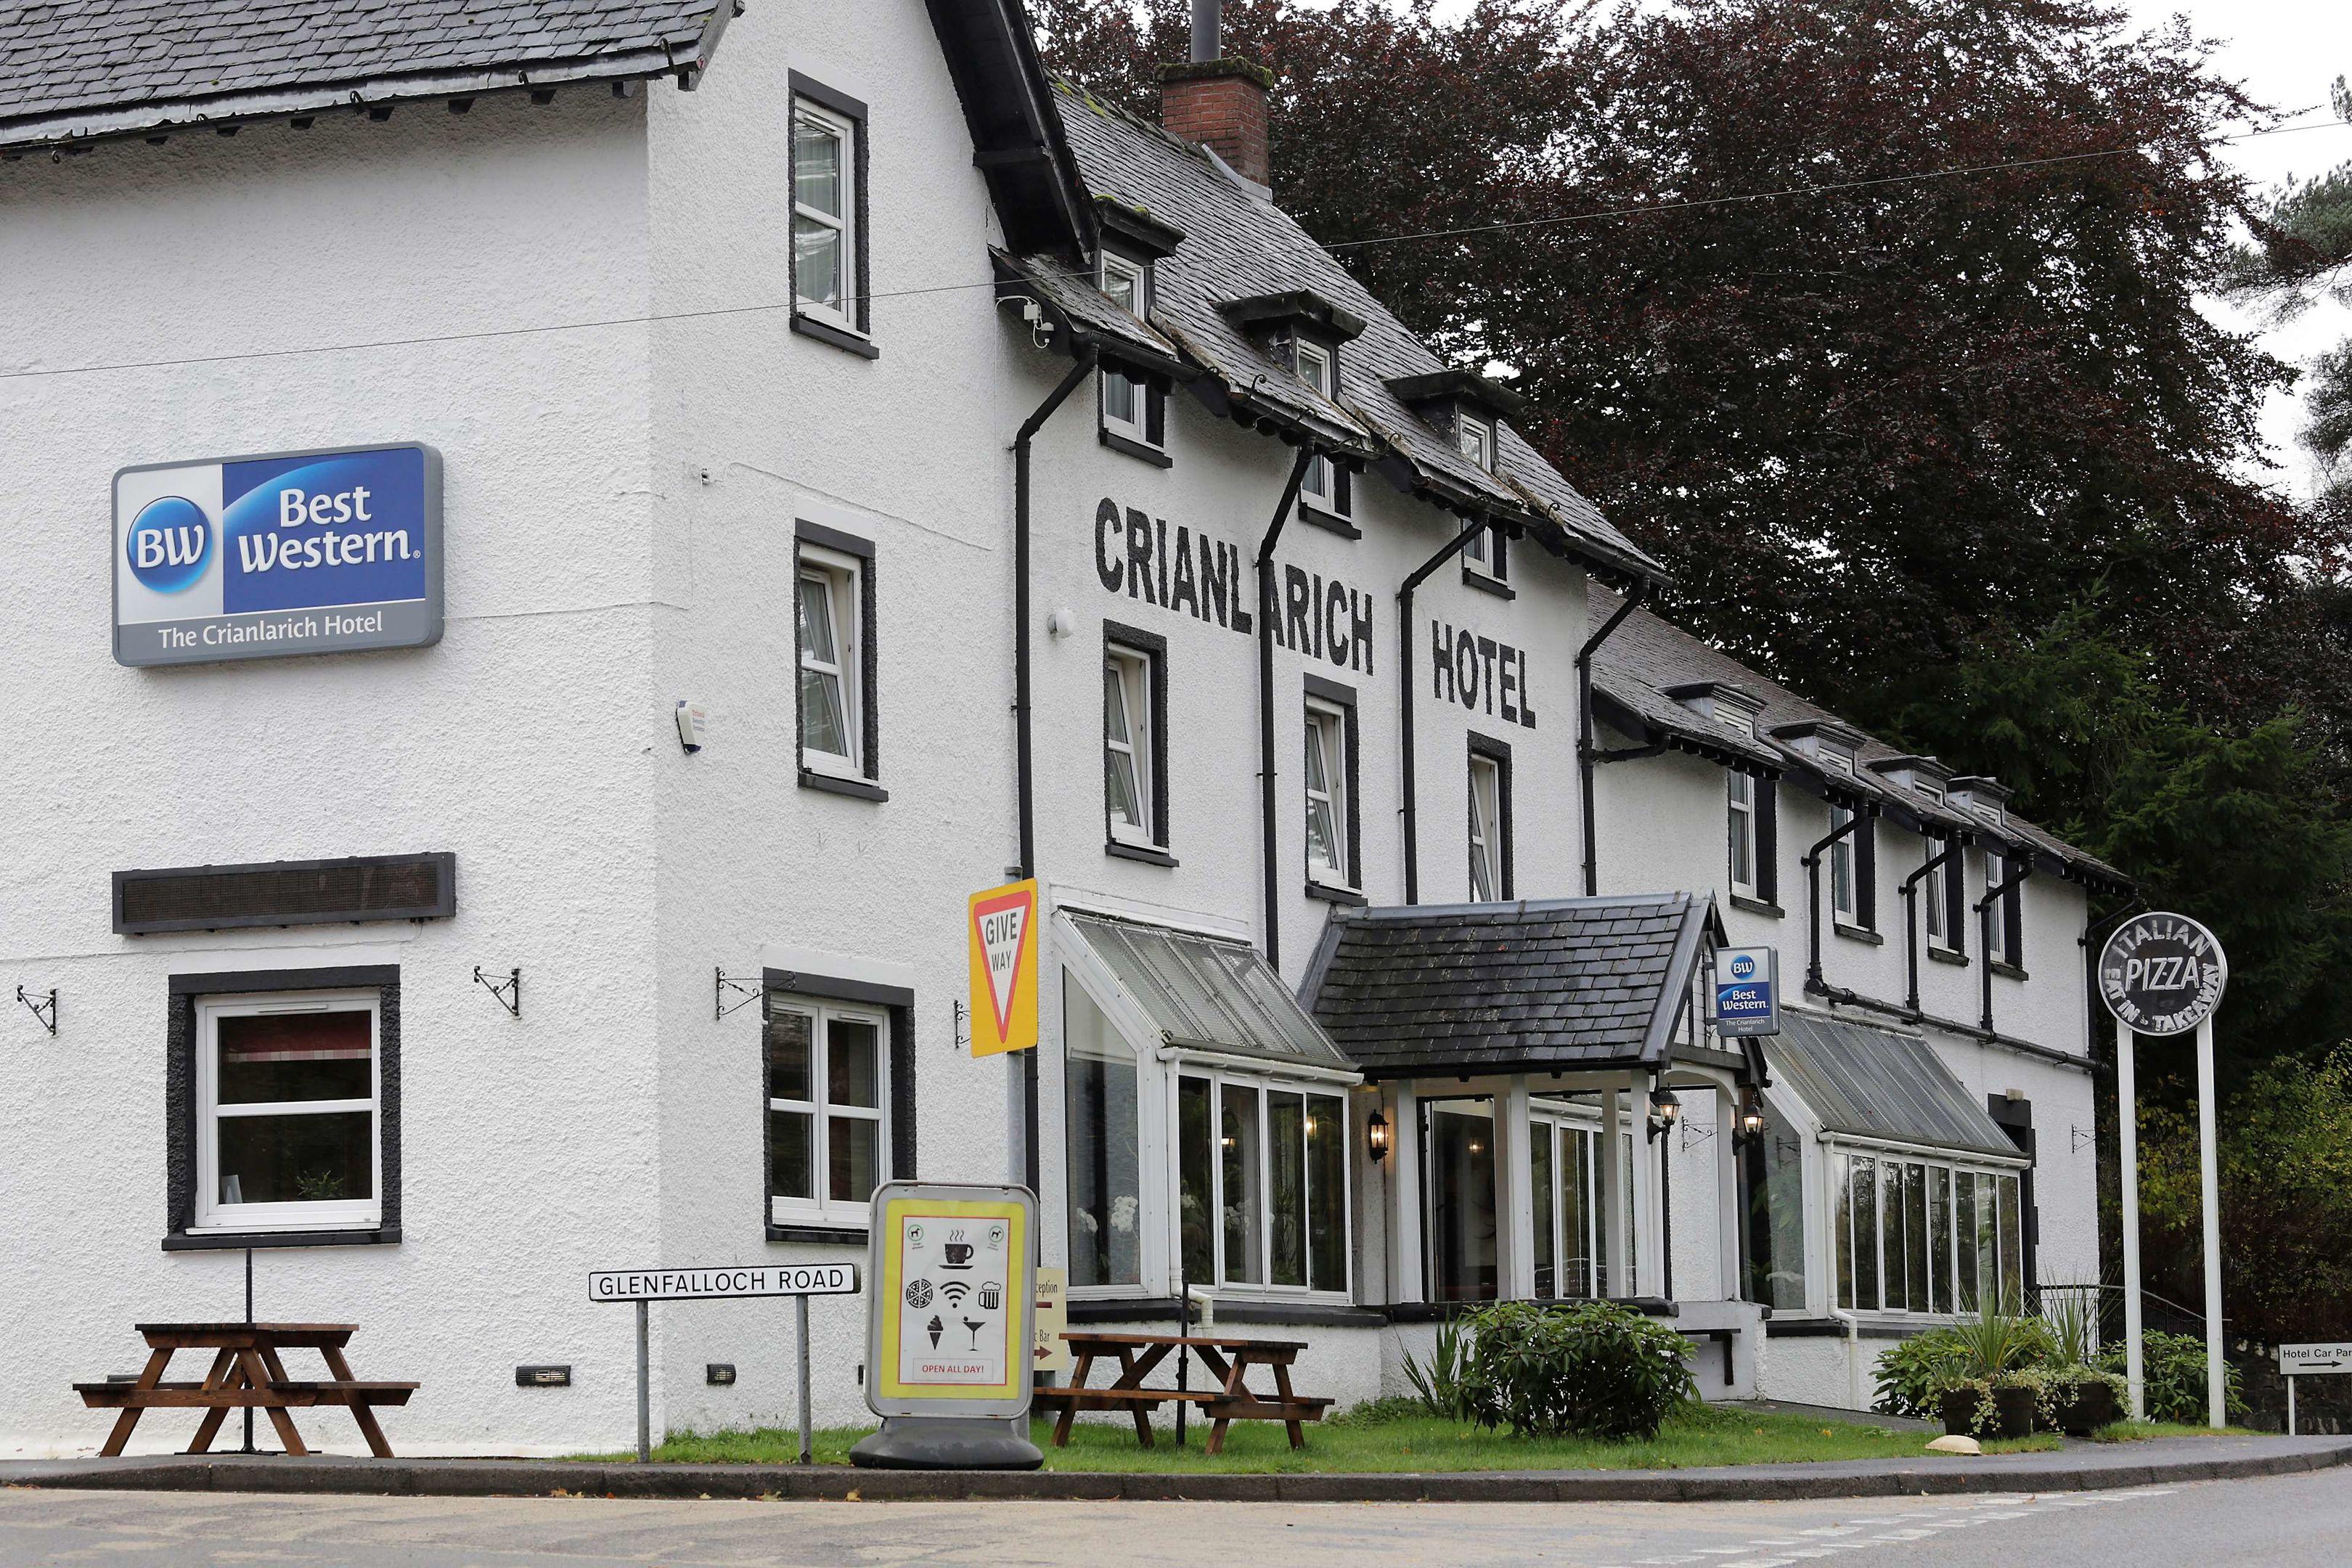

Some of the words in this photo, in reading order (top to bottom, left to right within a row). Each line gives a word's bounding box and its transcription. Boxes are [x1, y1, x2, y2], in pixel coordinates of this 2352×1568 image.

[280, 486, 372, 528] Best
[136, 524, 205, 568] BW
[158, 629, 197, 648] The
[203, 616, 318, 645] Crianlarich
[324, 611, 383, 636] Hotel
[1095, 497, 1373, 676] CRIANLARICH
[1432, 619, 1536, 729] HOTEL
[986, 912, 1017, 945] GIVE
[2111, 920, 2211, 959] ITALIAN
[992, 950, 1012, 972] WAY
[1733, 962, 1753, 974] BW
[2125, 956, 2200, 992] PIZZA
[1732, 990, 1756, 1000] Best
[2105, 968, 2126, 1000] EAT
[2117, 1000, 2140, 1023] IN
[2152, 963, 2218, 1032] TAKEAWAY
[599, 1272, 764, 1295] GLENFALLOCH
[779, 1270, 844, 1290] ROAD
[1040, 1329, 1050, 1342] Bar
[947, 1365, 962, 1373] ALL
[2283, 1349, 2310, 1358] Hotel
[2336, 1348, 2352, 1357] Par
